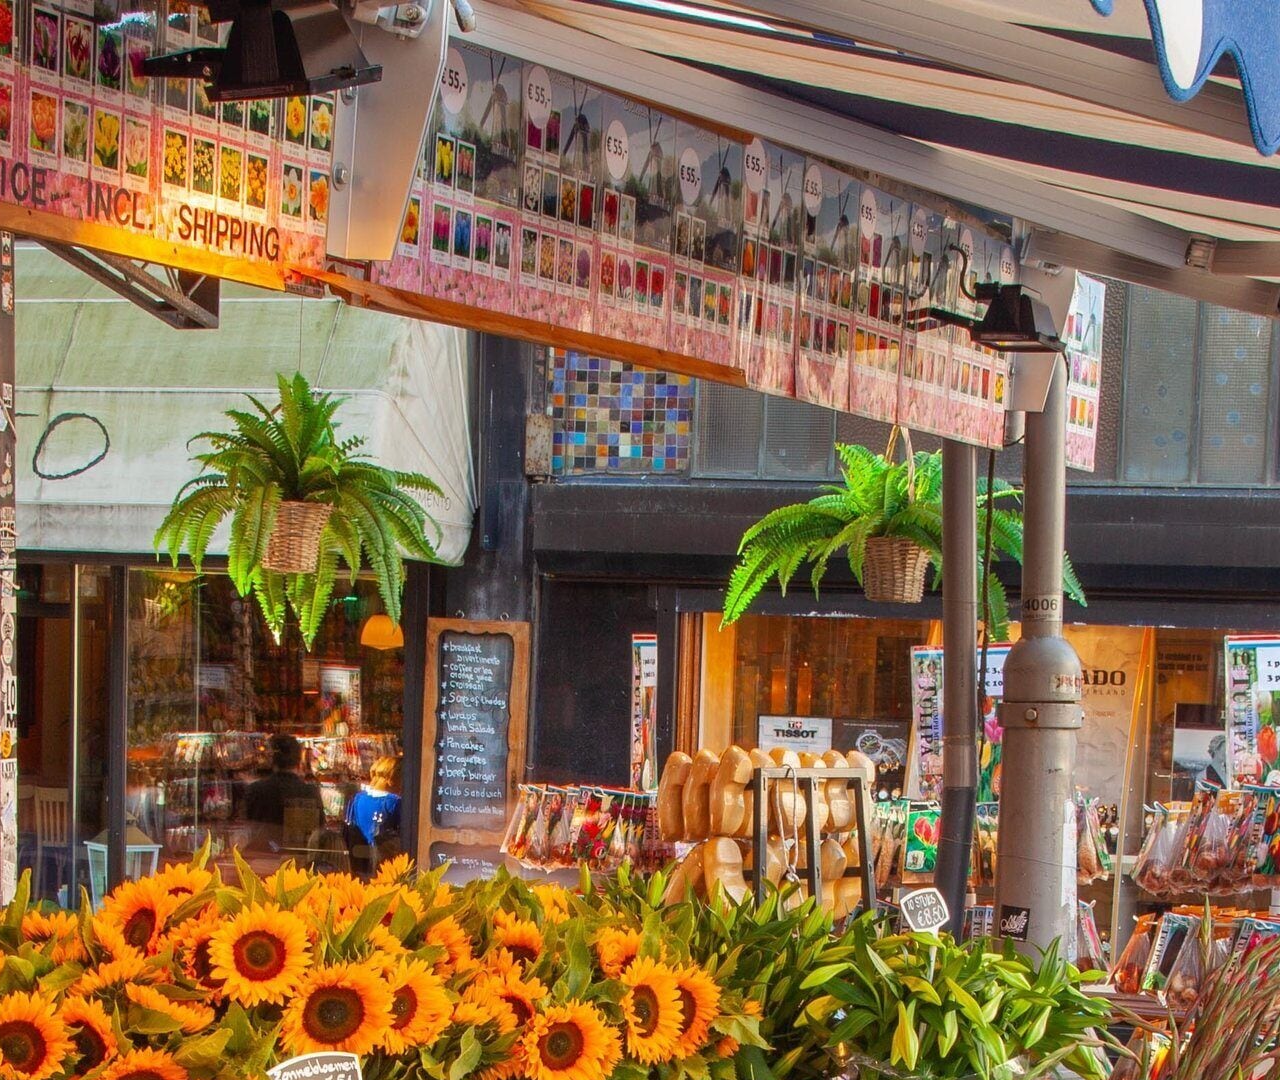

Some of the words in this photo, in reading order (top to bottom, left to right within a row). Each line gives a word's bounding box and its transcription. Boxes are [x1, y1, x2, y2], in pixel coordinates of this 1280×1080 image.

[86, 182, 154, 230] INCL.
[178, 203, 280, 262] SHIPPING
[1024, 599, 1058, 611] 4006
[1232, 651, 1250, 667] 10
[1082, 670, 1126, 686] ADO
[919, 686, 937, 757] TULIPA
[774, 729, 817, 738] TISSOT
[444, 786, 461, 796] Club
[916, 893, 936, 908] STUKS
